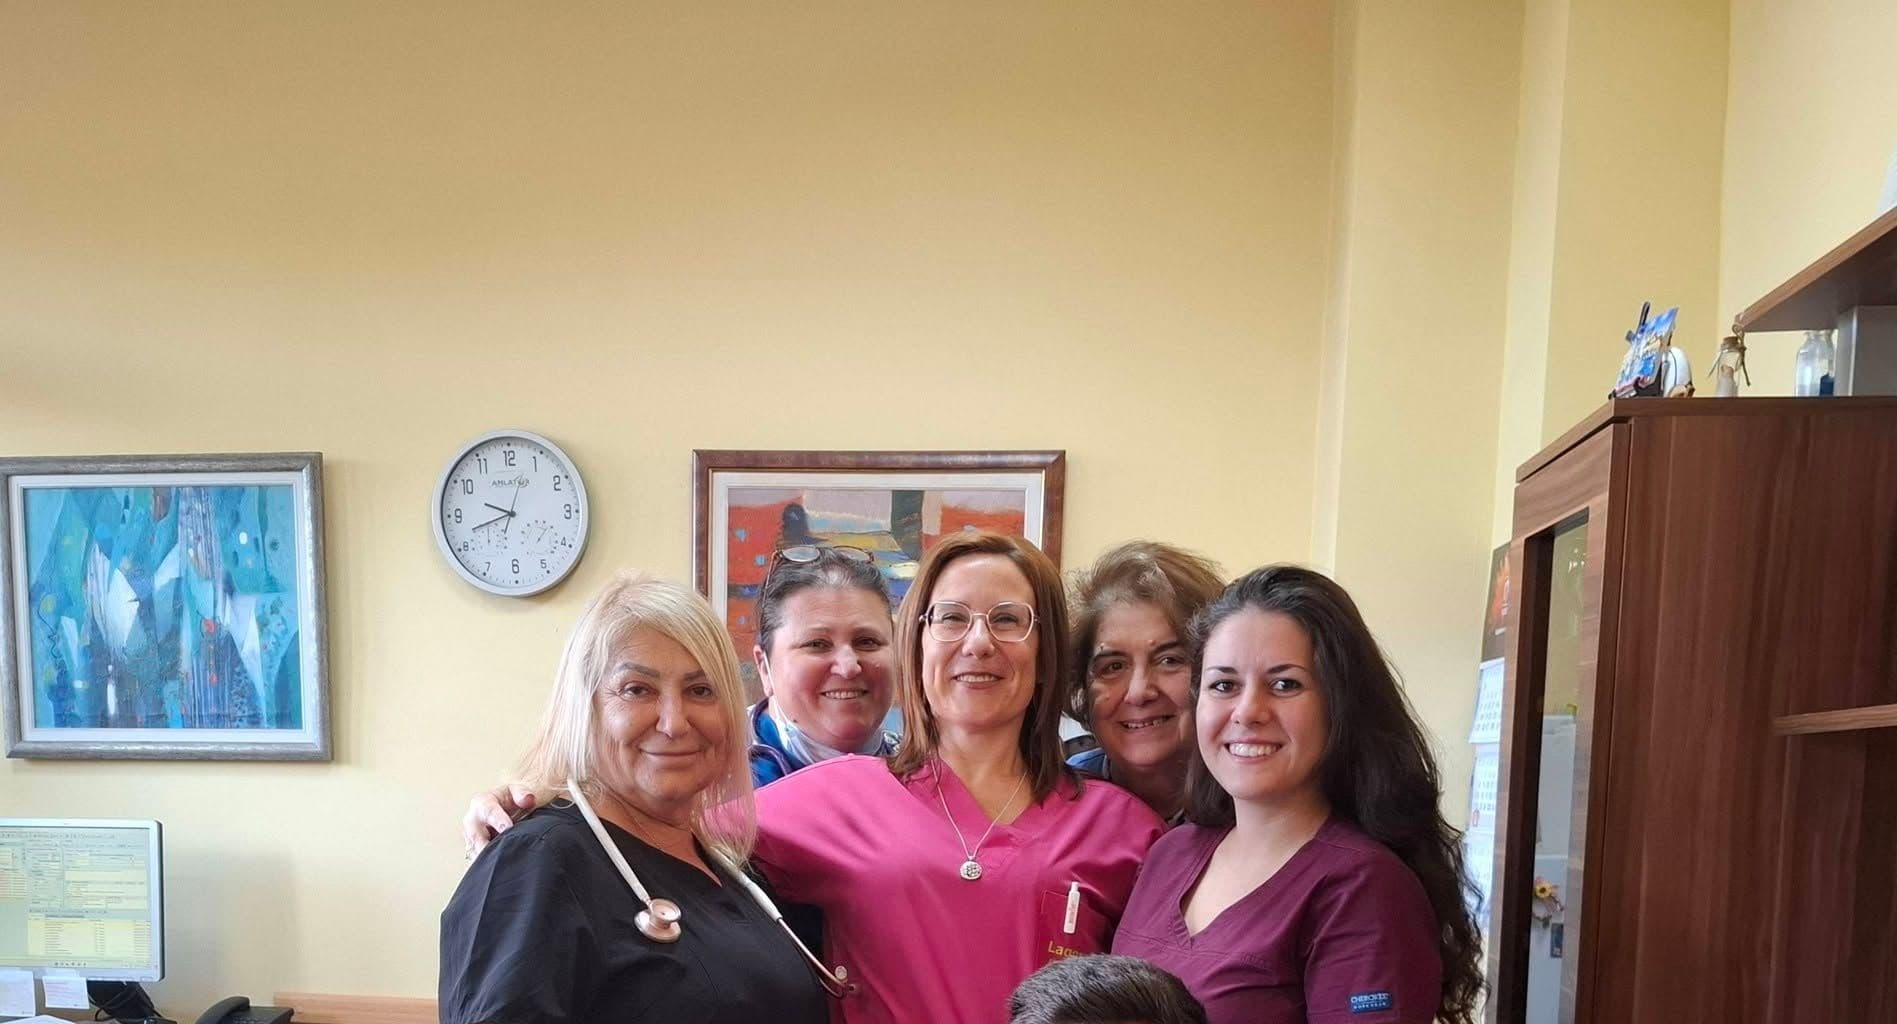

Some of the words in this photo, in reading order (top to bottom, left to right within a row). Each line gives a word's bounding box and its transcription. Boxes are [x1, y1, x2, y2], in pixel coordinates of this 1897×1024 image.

[477, 458, 488, 474] 11
[503, 450, 516, 466] 12
[532, 456, 538, 472] 1
[461, 479, 474, 495] 10
[553, 475, 562, 491] 2
[454, 508, 462, 524] 9
[564, 503, 572, 520] 3
[462, 541, 469, 551] 8
[560, 536, 567, 547] 4
[485, 562, 491, 572] 7
[512, 559, 520, 574] 6
[540, 559, 547, 569] 5
